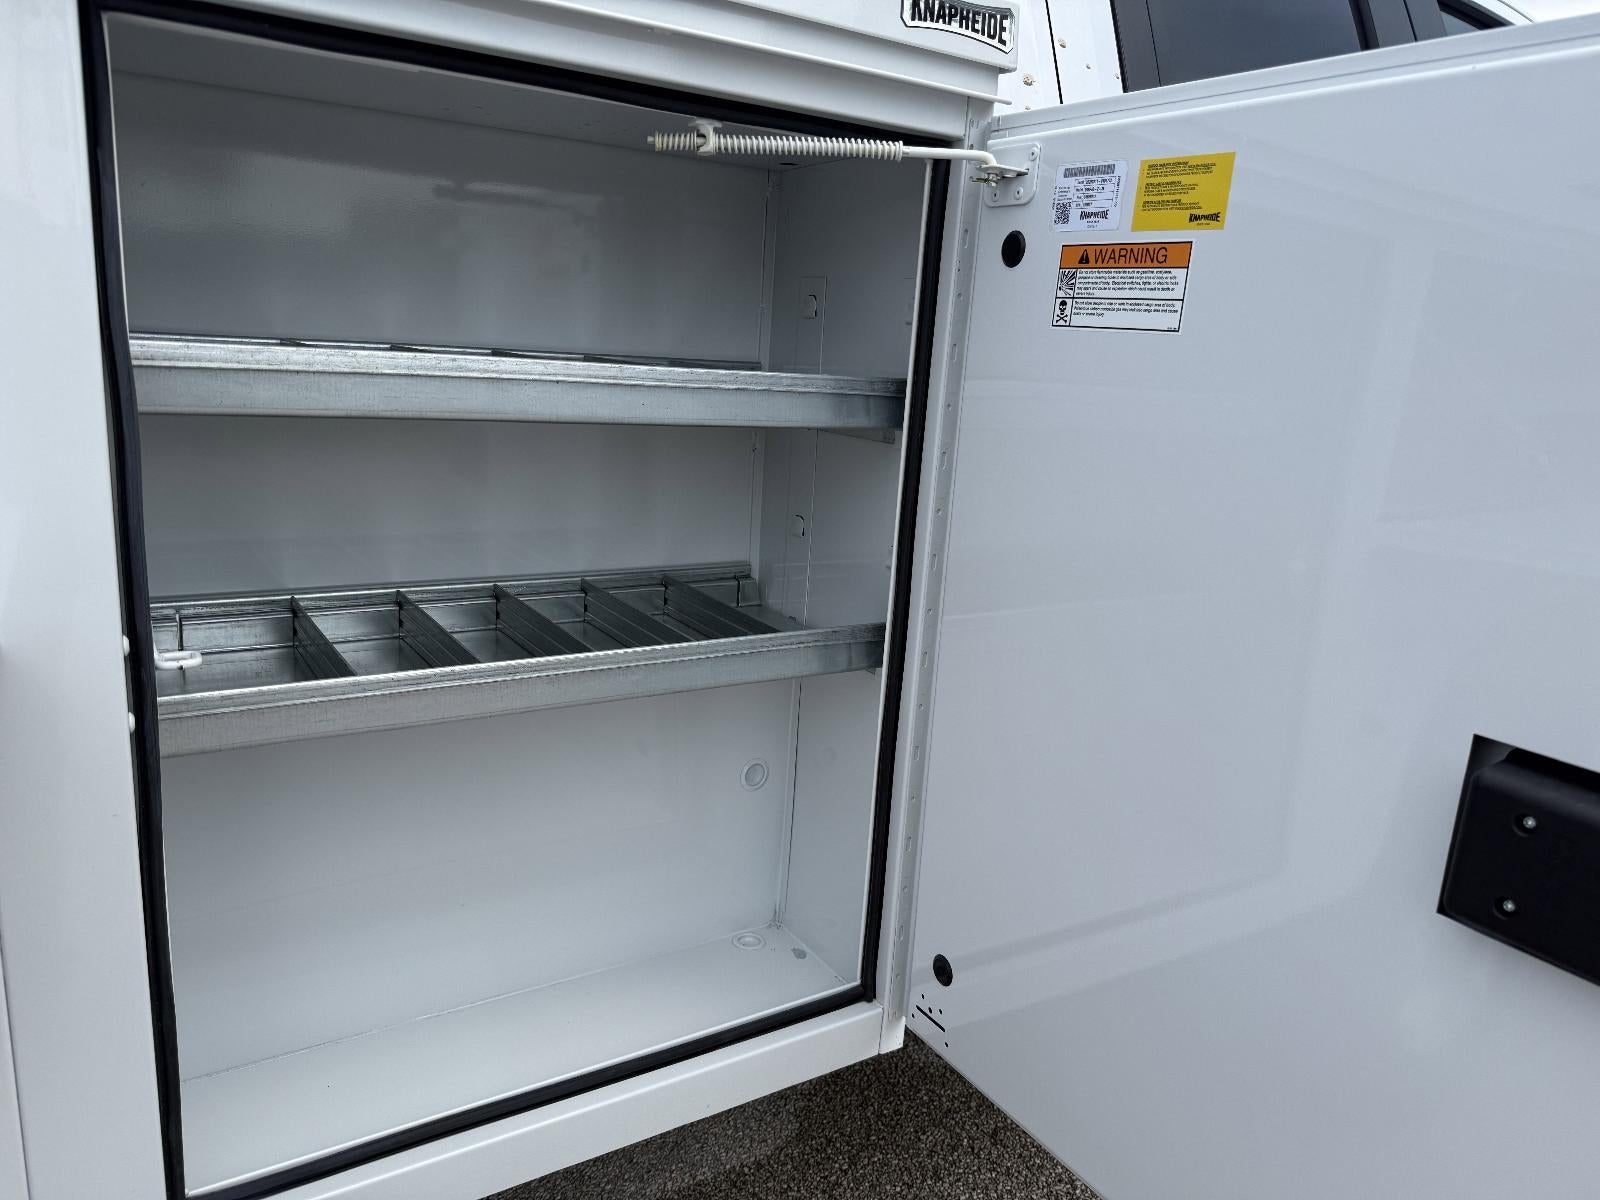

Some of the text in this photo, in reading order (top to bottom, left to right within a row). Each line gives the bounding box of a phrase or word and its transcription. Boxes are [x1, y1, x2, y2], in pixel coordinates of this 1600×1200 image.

[911, 0, 1008, 47] KNAPHEIDE
[1079, 209, 1109, 221] KNAPHEIDE
[1189, 212, 1221, 223] KNAPHEIDE
[1094, 247, 1168, 265] WARNING
